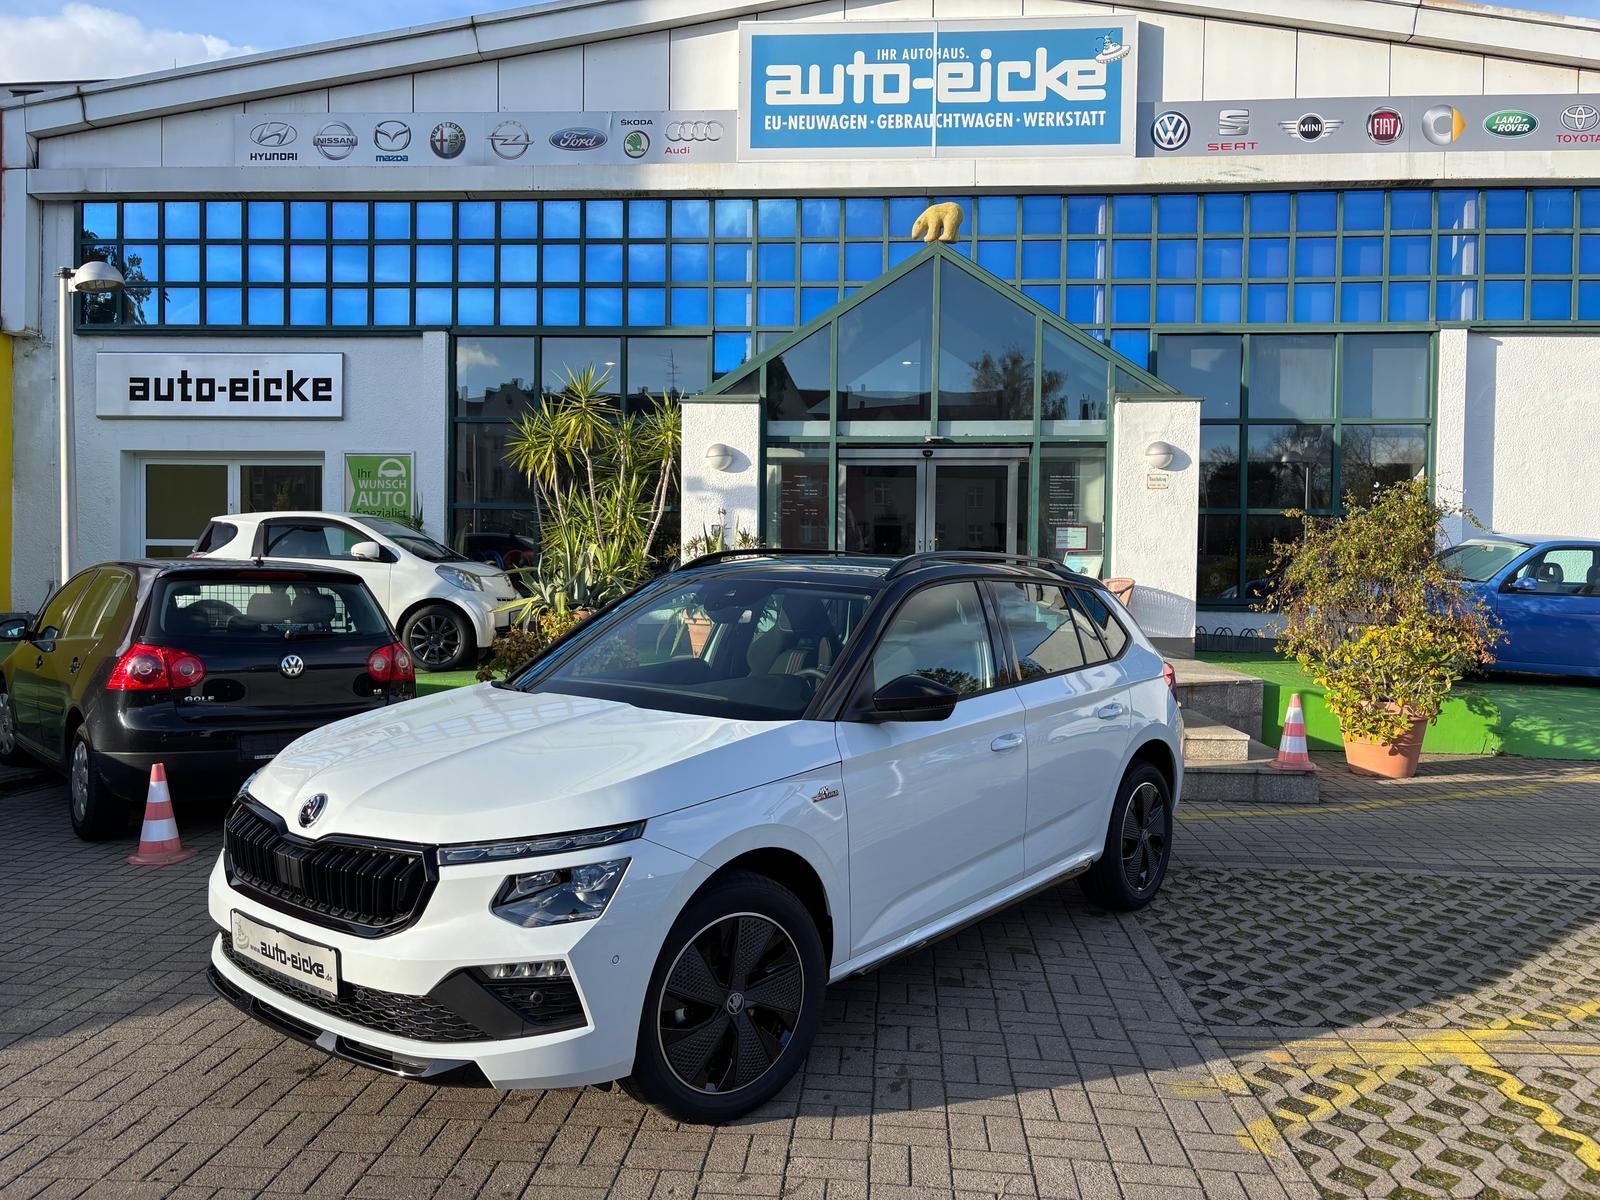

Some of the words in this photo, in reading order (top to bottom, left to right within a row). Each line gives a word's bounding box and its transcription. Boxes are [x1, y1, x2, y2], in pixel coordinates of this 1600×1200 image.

[876, 48, 897, 61] IHR
[902, 47, 969, 60] AUTOHAUS.
[765, 47, 1106, 105] auto-eicke
[620, 118, 653, 126] ŠKODA
[765, 114, 867, 131] EU-NEUWAGEN
[877, 111, 1013, 130] GEBRAUCHTWAGEN
[1023, 110, 1106, 128] WERKSTATT
[1373, 118, 1396, 135] FIAT
[1300, 124, 1321, 132] MINI
[559, 131, 596, 147] Ford
[664, 146, 691, 154] Audi
[1207, 142, 1258, 151] SEAT
[249, 152, 298, 161] HYUNDAI
[129, 369, 332, 402] auto-eicke
[357, 467, 372, 478] Ihr
[358, 480, 407, 489] WUNSCH
[356, 491, 407, 507] AUTO
